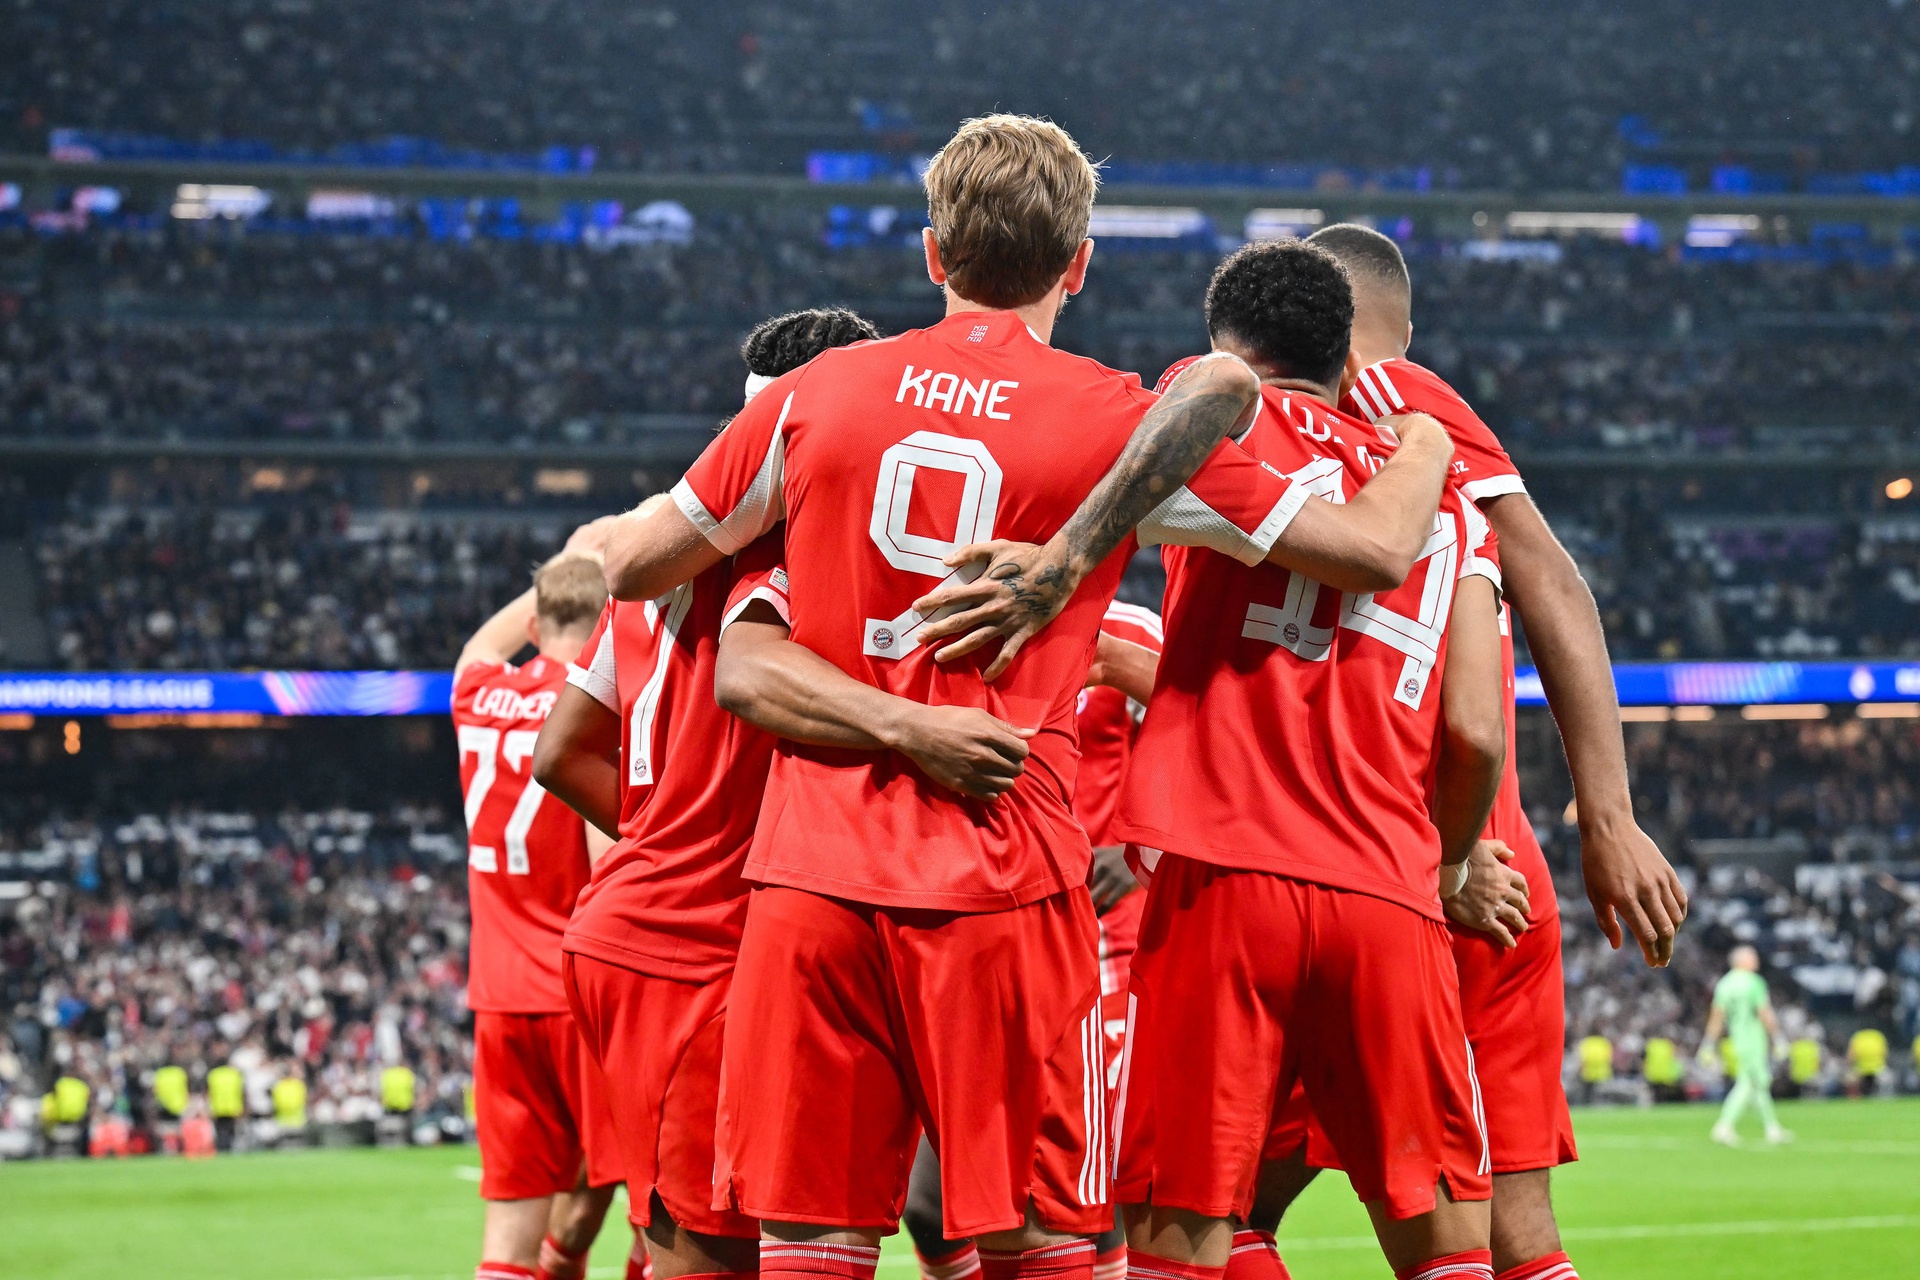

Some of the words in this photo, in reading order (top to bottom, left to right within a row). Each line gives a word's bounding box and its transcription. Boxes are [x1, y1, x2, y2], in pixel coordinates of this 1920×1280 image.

[895, 364, 1020, 421] KANE
[863, 430, 1004, 660] 9
[1240, 453, 1458, 712] 14
[472, 686, 557, 720] LAIMER
[630, 577, 694, 787] 7
[458, 724, 547, 875] 27
